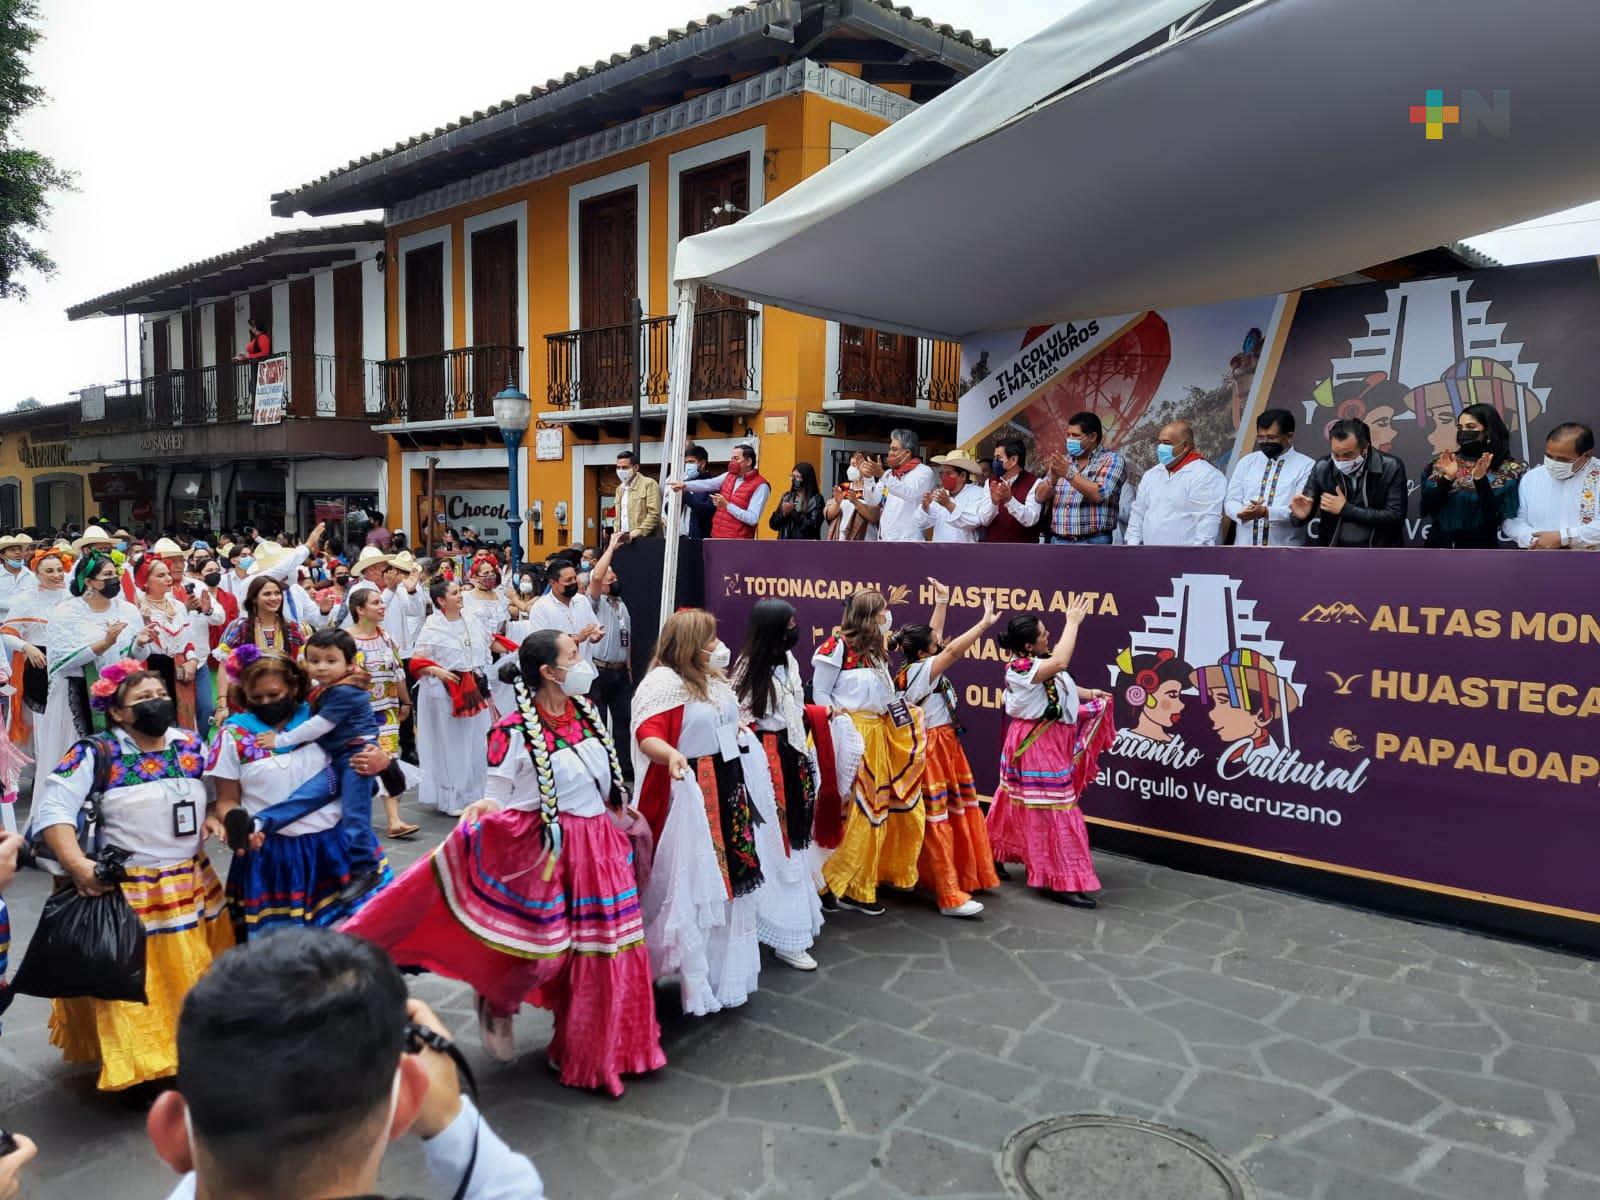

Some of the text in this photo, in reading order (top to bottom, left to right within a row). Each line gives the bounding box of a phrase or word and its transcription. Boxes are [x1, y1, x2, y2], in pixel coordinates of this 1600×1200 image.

[989, 320, 1100, 409] DE MATAMOROS
[996, 322, 1077, 387] TLACOLULA
[1030, 366, 1059, 389] OAXACA
[448, 496, 511, 520] Chocola
[919, 585, 1044, 612] HASTECA
[1369, 605, 1501, 638] ALTAS
[1371, 669, 1600, 717] HUASTECA
[1108, 733, 1370, 793] cuentro Cultural
[1375, 732, 1600, 784] PAPALOAP
[1115, 770, 1188, 800] Orgullo
[1193, 782, 1342, 826] Veracruzano
